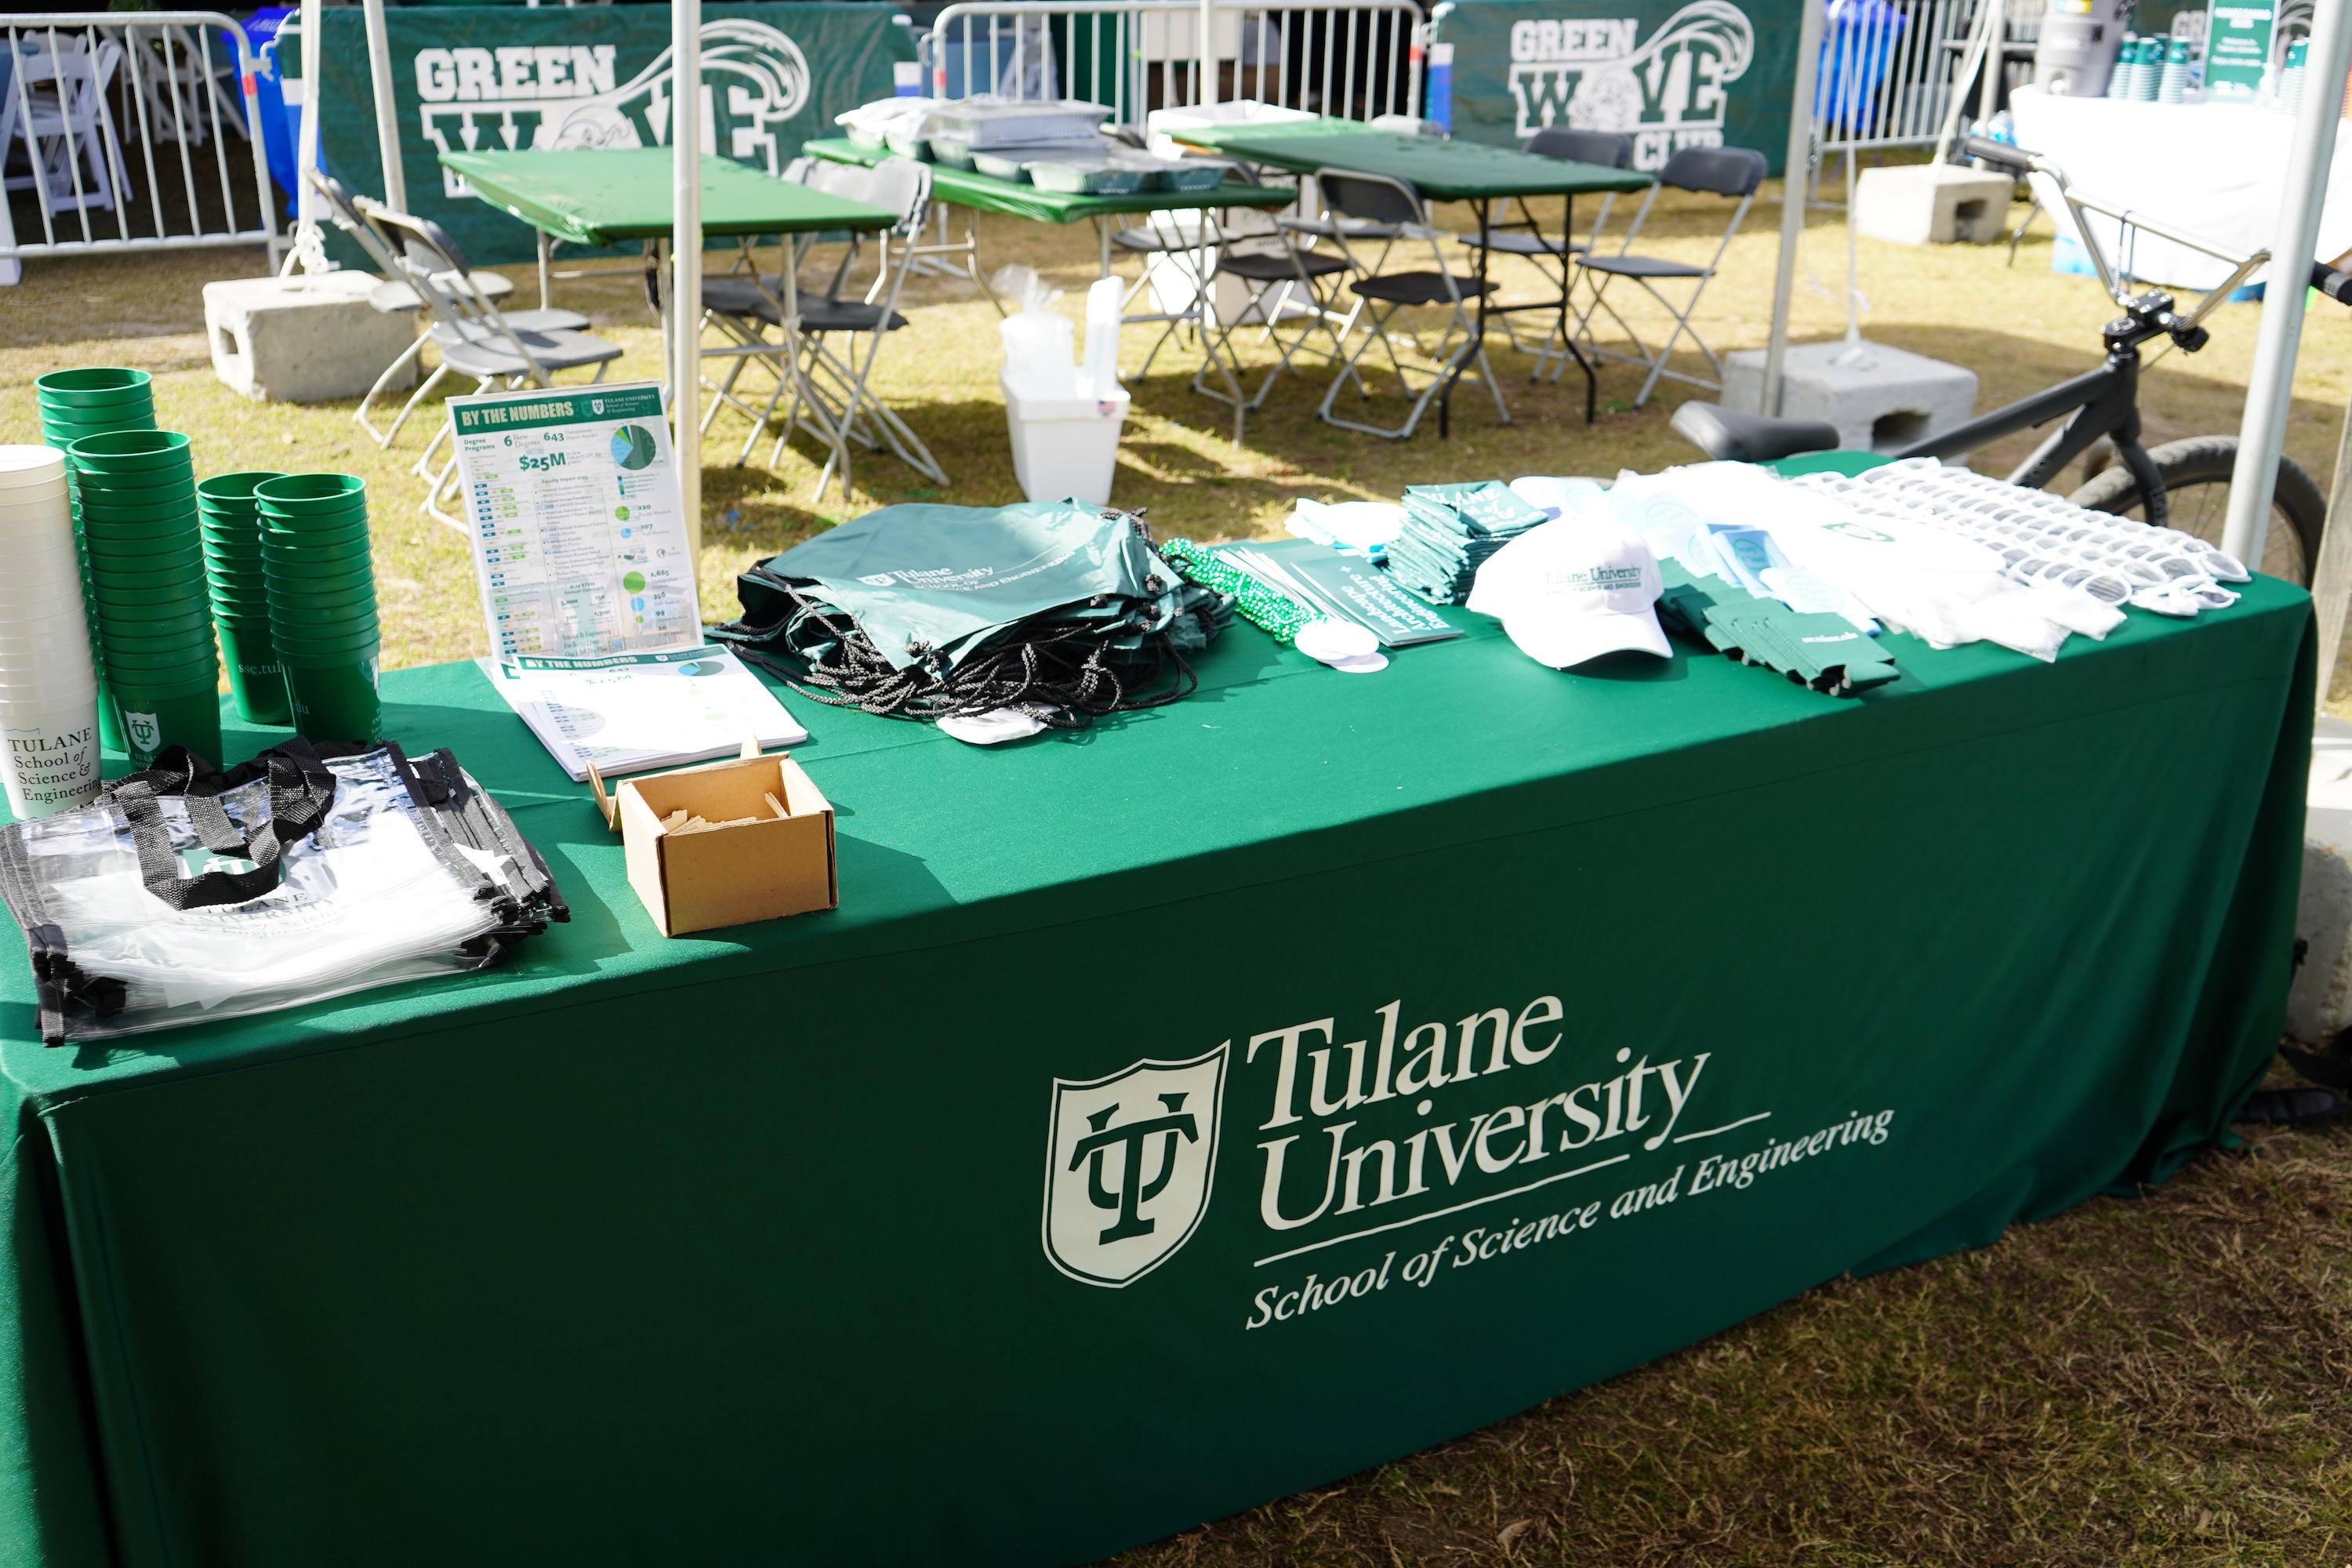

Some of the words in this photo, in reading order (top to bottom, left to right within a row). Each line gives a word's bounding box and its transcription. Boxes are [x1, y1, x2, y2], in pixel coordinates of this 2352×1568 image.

[1511, 19, 1639, 62] GREEN
[414, 45, 616, 101] GREEN
[1508, 42, 1728, 138] WVE
[461, 410, 479, 426] BY
[481, 408, 508, 424] THE
[508, 401, 574, 422] NUMBERS
[465, 444, 495, 452] Programs
[504, 435, 513, 446] 6
[514, 440, 540, 448] Degrees
[543, 433, 564, 441] 643
[519, 452, 566, 471] $25M
[887, 567, 954, 579] Tulane
[900, 566, 994, 585] University
[975, 579, 999, 590] AND
[999, 551, 1076, 584] ENGINEERING
[1543, 571, 1588, 585] Tulane
[1589, 564, 1642, 581] University
[653, 591, 666, 600] 356
[1349, 574, 1432, 630] Architecture
[1369, 574, 1451, 630] Engineering
[1341, 586, 1411, 635] Landscape
[524, 659, 544, 668] BY
[545, 659, 571, 668] THE
[572, 656, 638, 668] NUMBERS
[8, 728, 92, 753] TULANE
[14, 752, 70, 769] School
[73, 746, 87, 765] of
[18, 771, 77, 785] Science
[79, 762, 91, 776] &
[22, 775, 102, 804] Engineering
[179, 898, 335, 924] UNIVERSITY
[205, 892, 307, 914] TULANE
[1246, 995, 1563, 1131] Tulane
[1257, 1047, 1711, 1231] University
[1245, 1251, 1396, 1330] School
[1402, 1236, 1455, 1288] of
[1452, 1200, 1601, 1269] Science
[1610, 1165, 1686, 1219] and
[1687, 1109, 1895, 1198] Engineering
